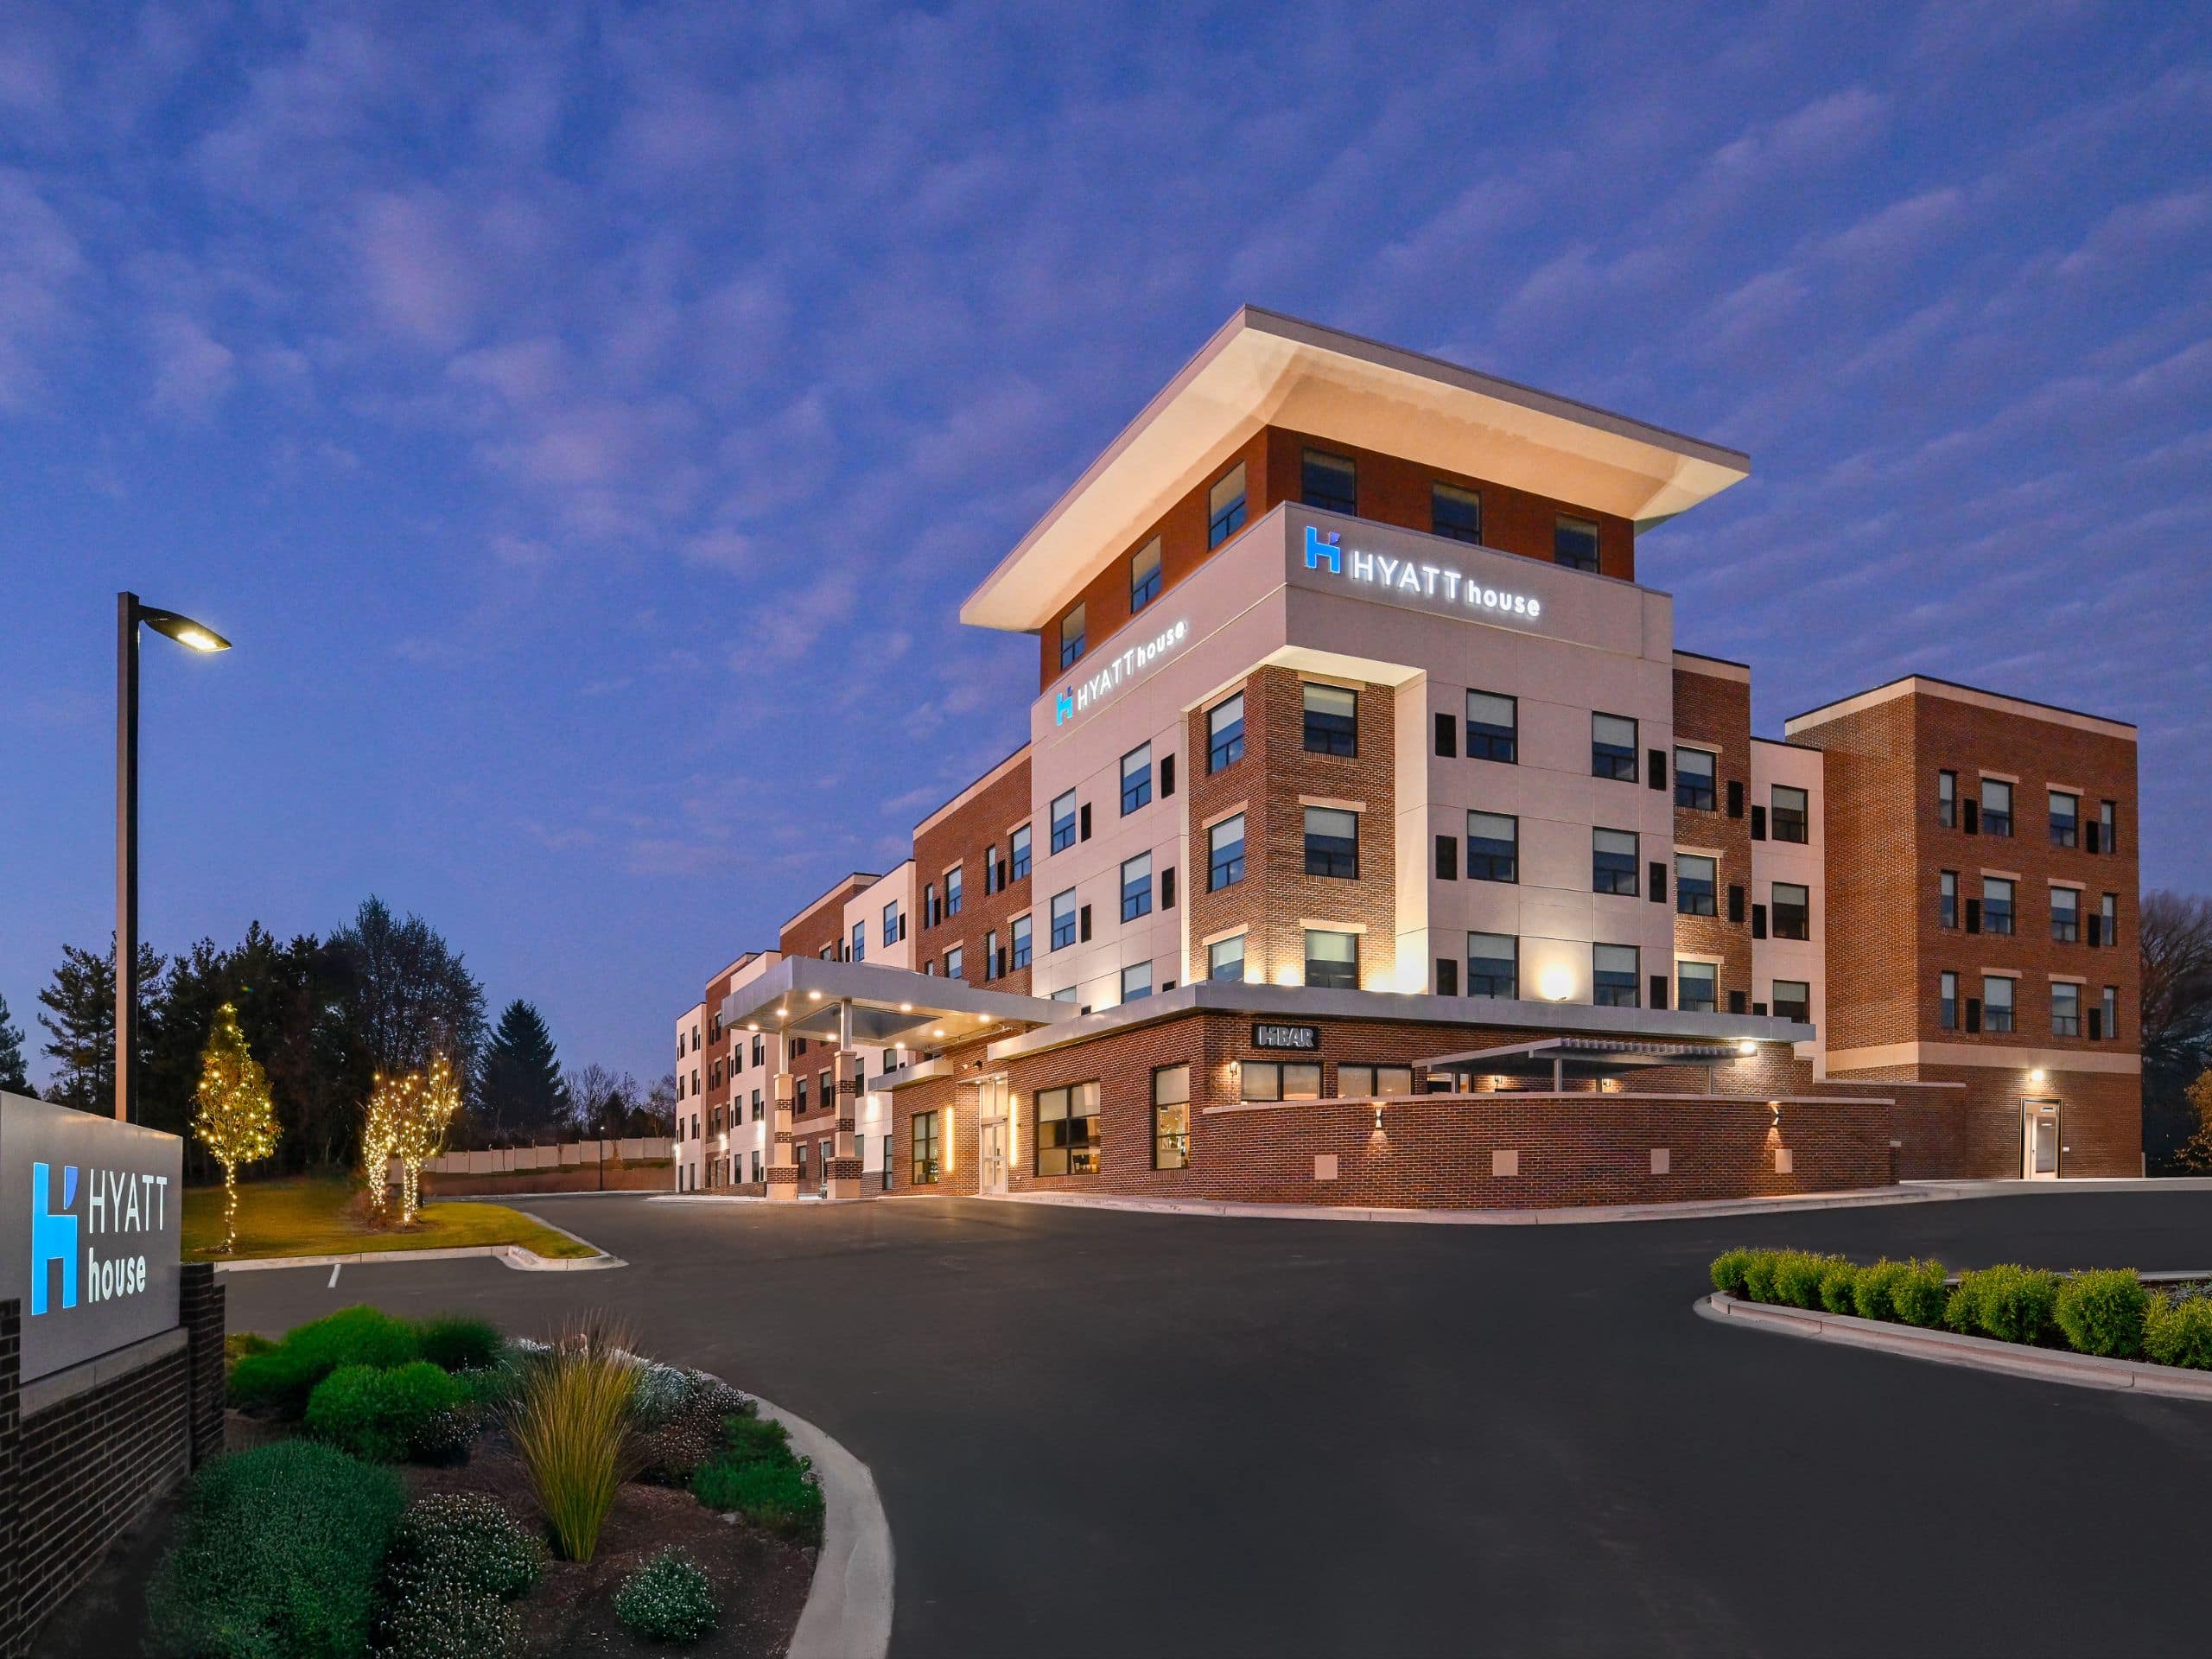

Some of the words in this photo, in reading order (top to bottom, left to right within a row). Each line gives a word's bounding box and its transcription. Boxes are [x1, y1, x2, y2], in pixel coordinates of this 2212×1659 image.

[1353, 550, 1462, 599] HYATT
[1468, 579, 1541, 617] house
[1077, 649, 1135, 711] HYATT
[1137, 620, 1186, 668] house
[89, 1168, 168, 1234] HYATT
[89, 1247, 146, 1303] house
